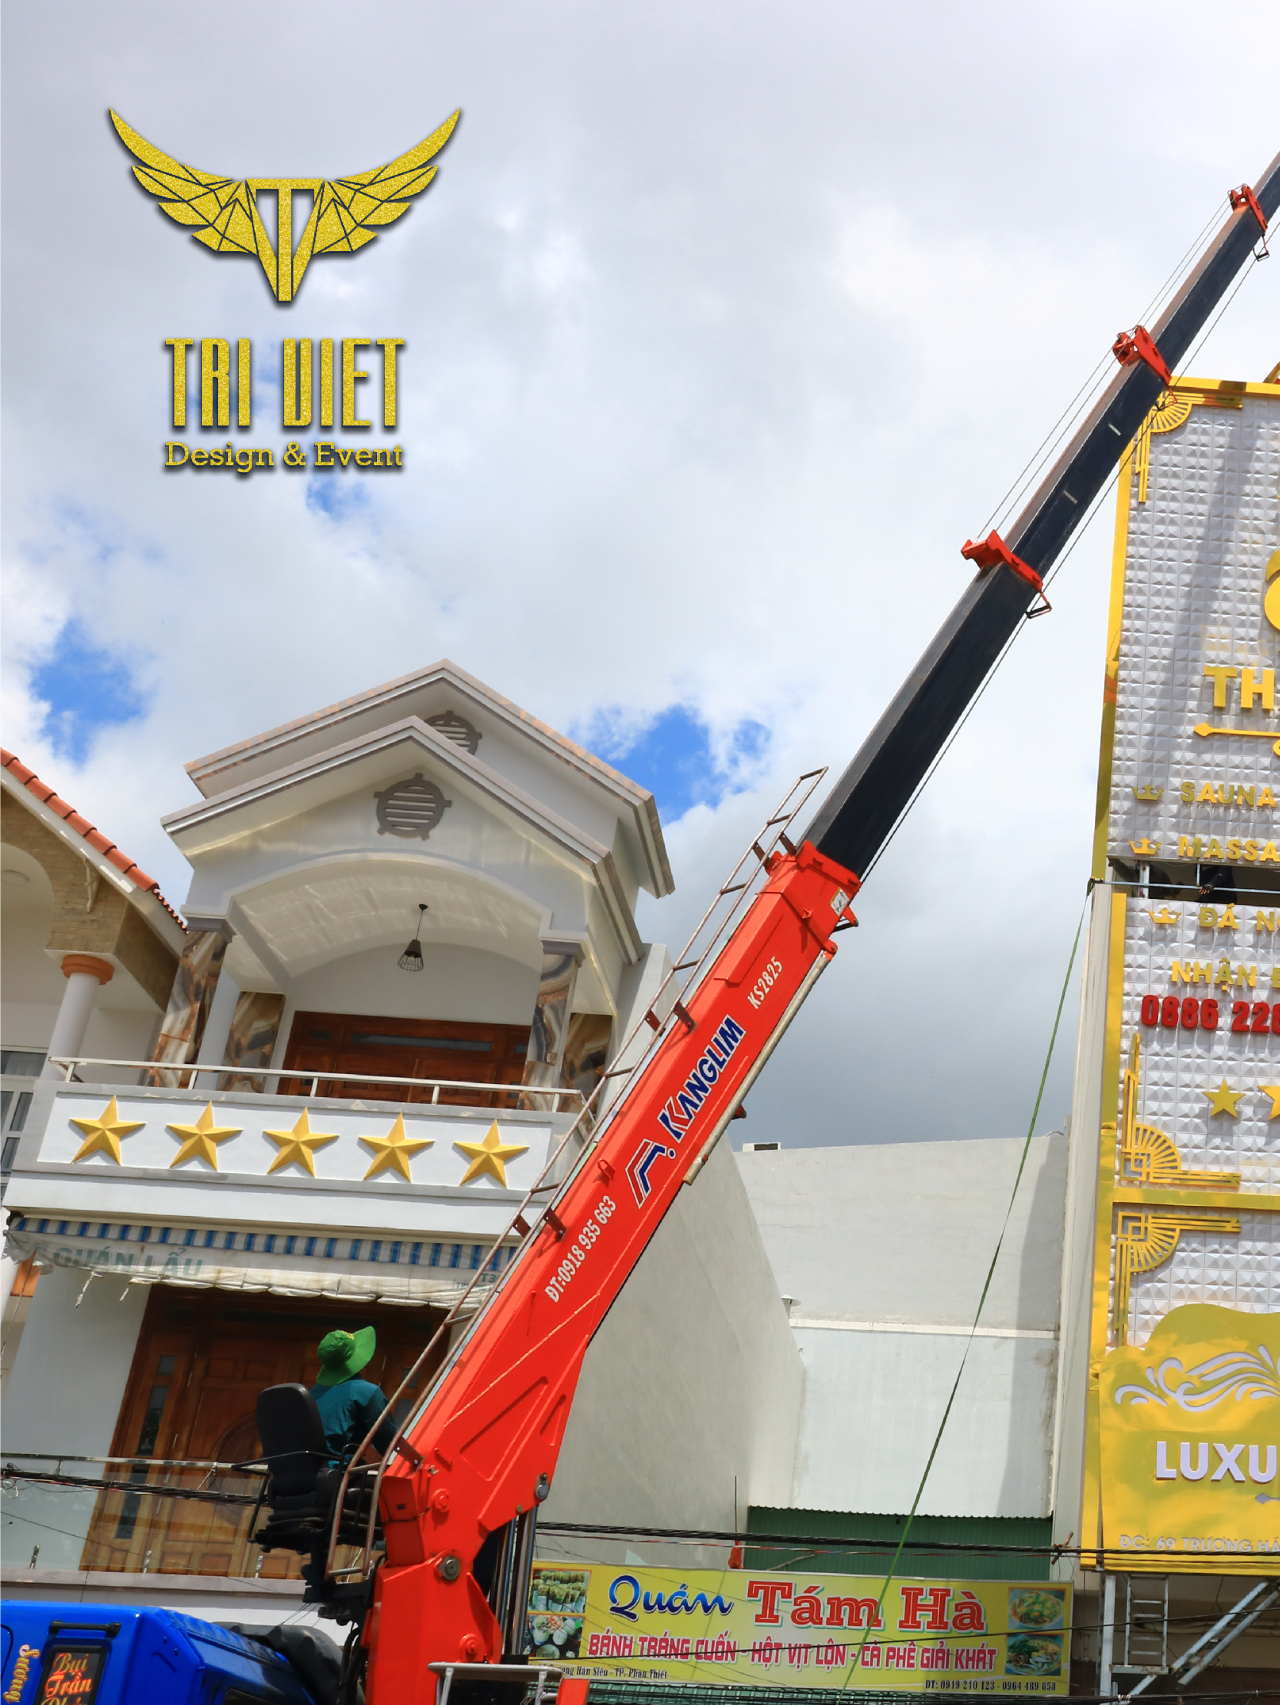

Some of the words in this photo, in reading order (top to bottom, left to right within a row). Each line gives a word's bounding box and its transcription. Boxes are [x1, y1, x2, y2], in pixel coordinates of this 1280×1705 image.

[1180, 781, 1277, 809] SAUNA
[1199, 903, 1239, 930] ĐÁ
[747, 956, 783, 1010] KS2825
[1171, 957, 1257, 991] NHẬN
[1141, 994, 1219, 1031] 0886
[656, 1014, 747, 1143] KANGLIM
[544, 1244, 586, 1303] ĐT:0918
[578, 1219, 601, 1250] 935
[594, 1195, 617, 1225] 663
[1119, 1534, 1150, 1548] ĐC:
[1156, 1536, 1176, 1550] 69
[1181, 1536, 1252, 1552] TRƯƠNG
[609, 1574, 734, 1622] Quán
[747, 1580, 883, 1630] Tám
[899, 1587, 987, 1633] Hà
[588, 1628, 634, 1658] BÁNH
[638, 1630, 691, 1661] TRÁNG
[694, 1631, 738, 1663] CUỐN
[750, 1635, 783, 1668] HỘT
[787, 1642, 812, 1669] VỊT
[815, 1638, 848, 1671] LỘN
[860, 1640, 882, 1668] CÀ
[885, 1641, 917, 1669] PHÊ
[920, 1640, 951, 1670] GIẢI
[954, 1642, 998, 1671] KHÁT
[44, 1670, 94, 1698] Trần
[628, 1668, 647, 1679] Phan
[650, 1669, 668, 1679] Thiết
[940, 1680, 961, 1690] 0919
[963, 1680, 978, 1690] 210
[981, 1680, 995, 1690] 123
[1002, 1681, 1022, 1691] 0964
[1025, 1681, 1039, 1691] 489
[1041, 1681, 1056, 1691] 858
